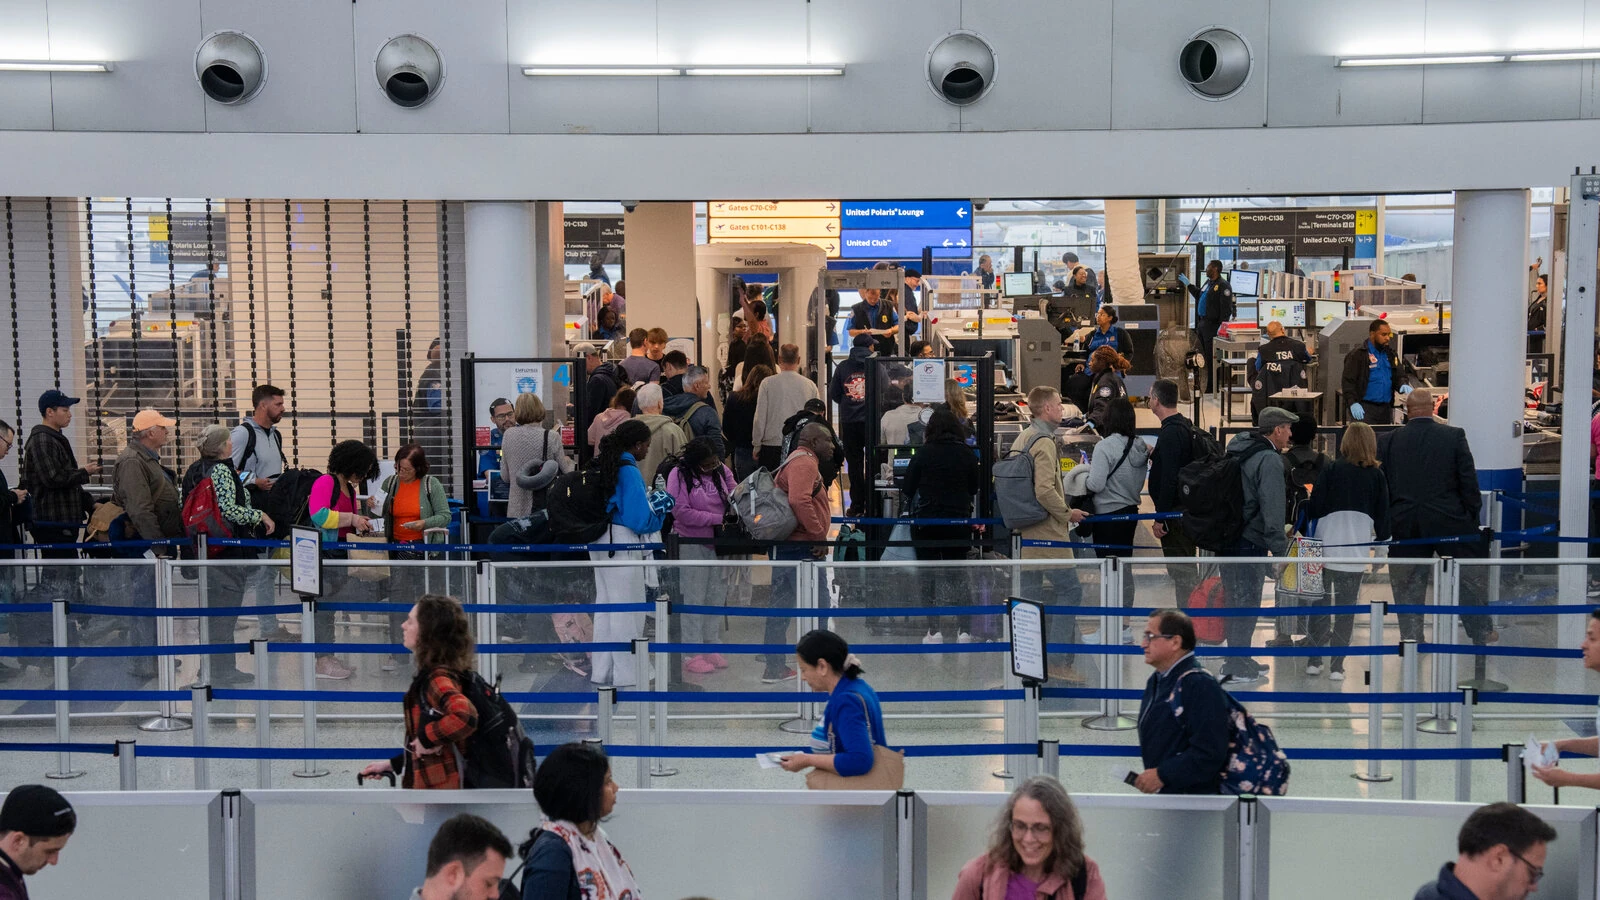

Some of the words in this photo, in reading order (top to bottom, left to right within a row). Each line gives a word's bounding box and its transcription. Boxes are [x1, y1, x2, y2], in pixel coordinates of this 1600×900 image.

[898, 208, 924, 217] Lounge
[1276, 350, 1293, 360] TSA
[1266, 362, 1282, 373] TSA
[553, 364, 570, 387] 4
[958, 364, 974, 388] 3
